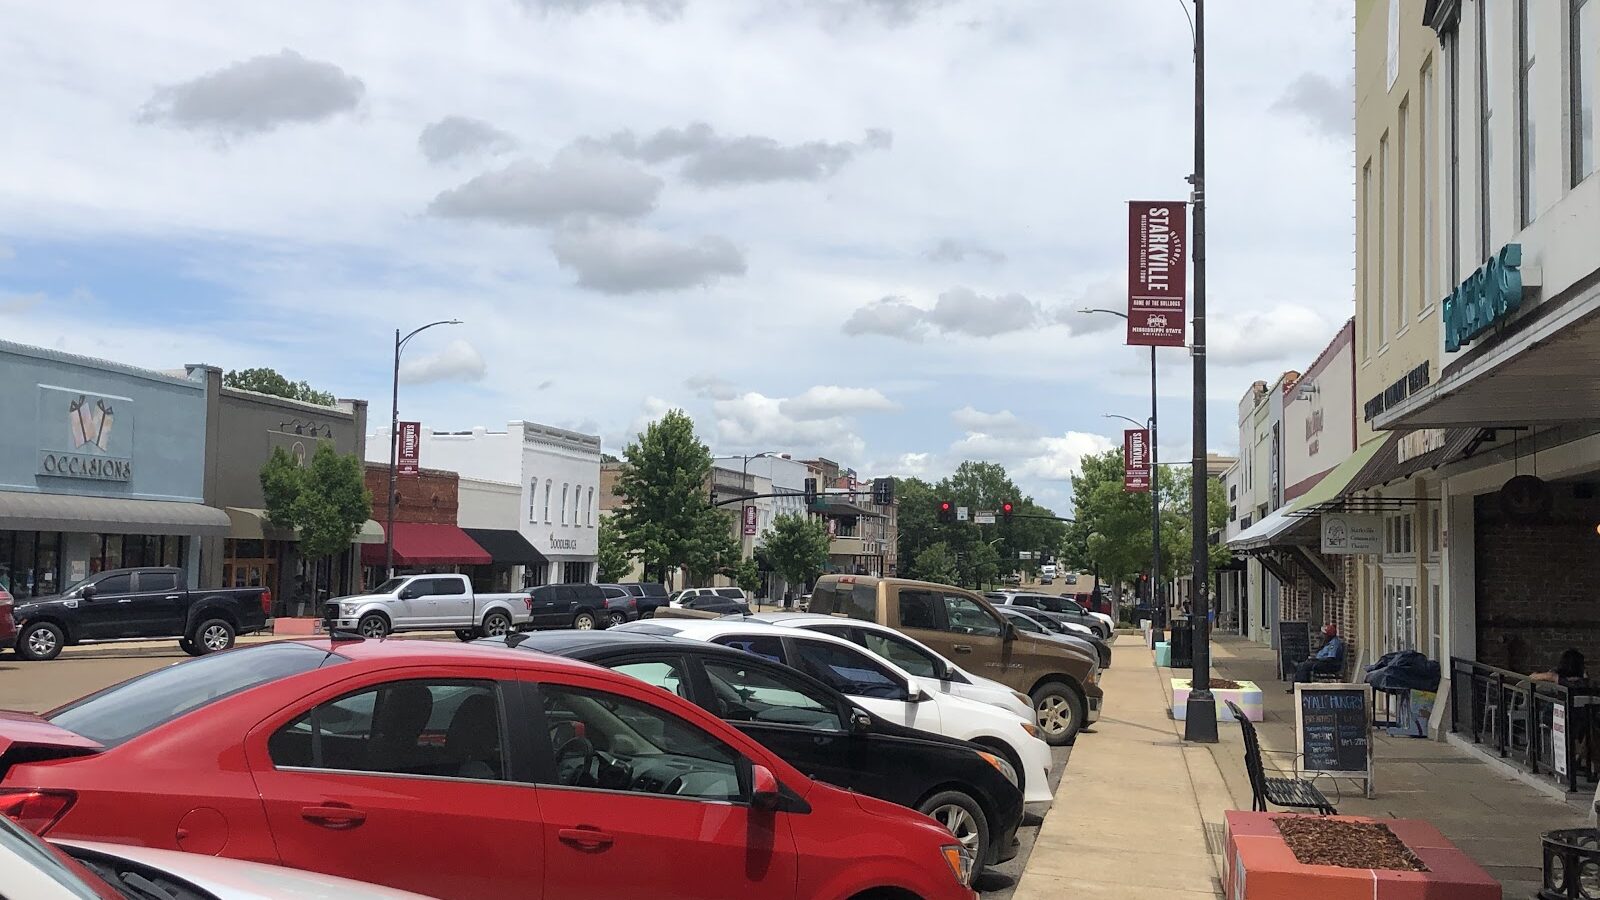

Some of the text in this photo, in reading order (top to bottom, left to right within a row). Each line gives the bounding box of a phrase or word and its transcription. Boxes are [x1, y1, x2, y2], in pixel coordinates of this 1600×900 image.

[1148, 207, 1169, 291] STARKVILLE
[1169, 231, 1182, 266] HISTORIC
[406, 424, 414, 457] STARKVILLE
[1132, 432, 1142, 468] STARKVILLE
[44, 454, 130, 478] OCCASIONS
[1330, 696, 1362, 710] HUNGRY
